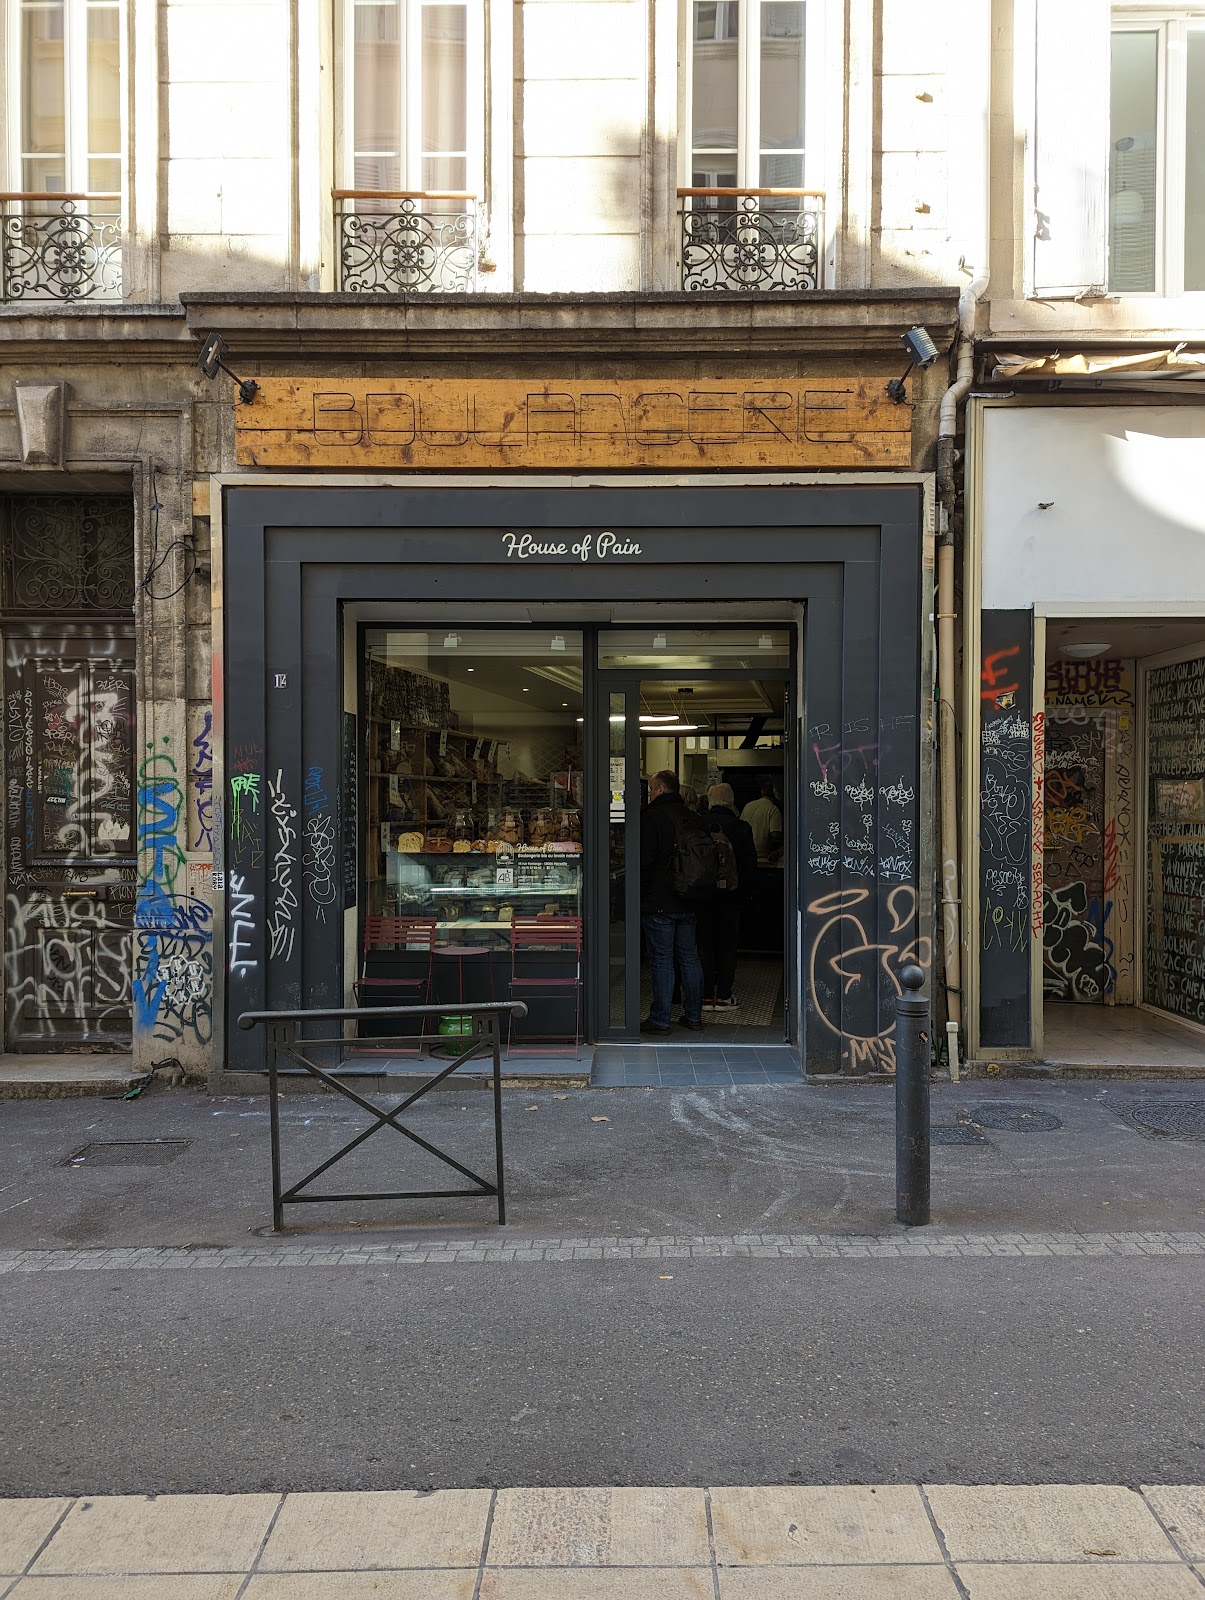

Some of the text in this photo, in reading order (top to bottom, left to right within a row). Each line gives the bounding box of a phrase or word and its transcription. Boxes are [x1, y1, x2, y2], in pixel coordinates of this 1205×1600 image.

[502, 531, 642, 562] House of Pain
